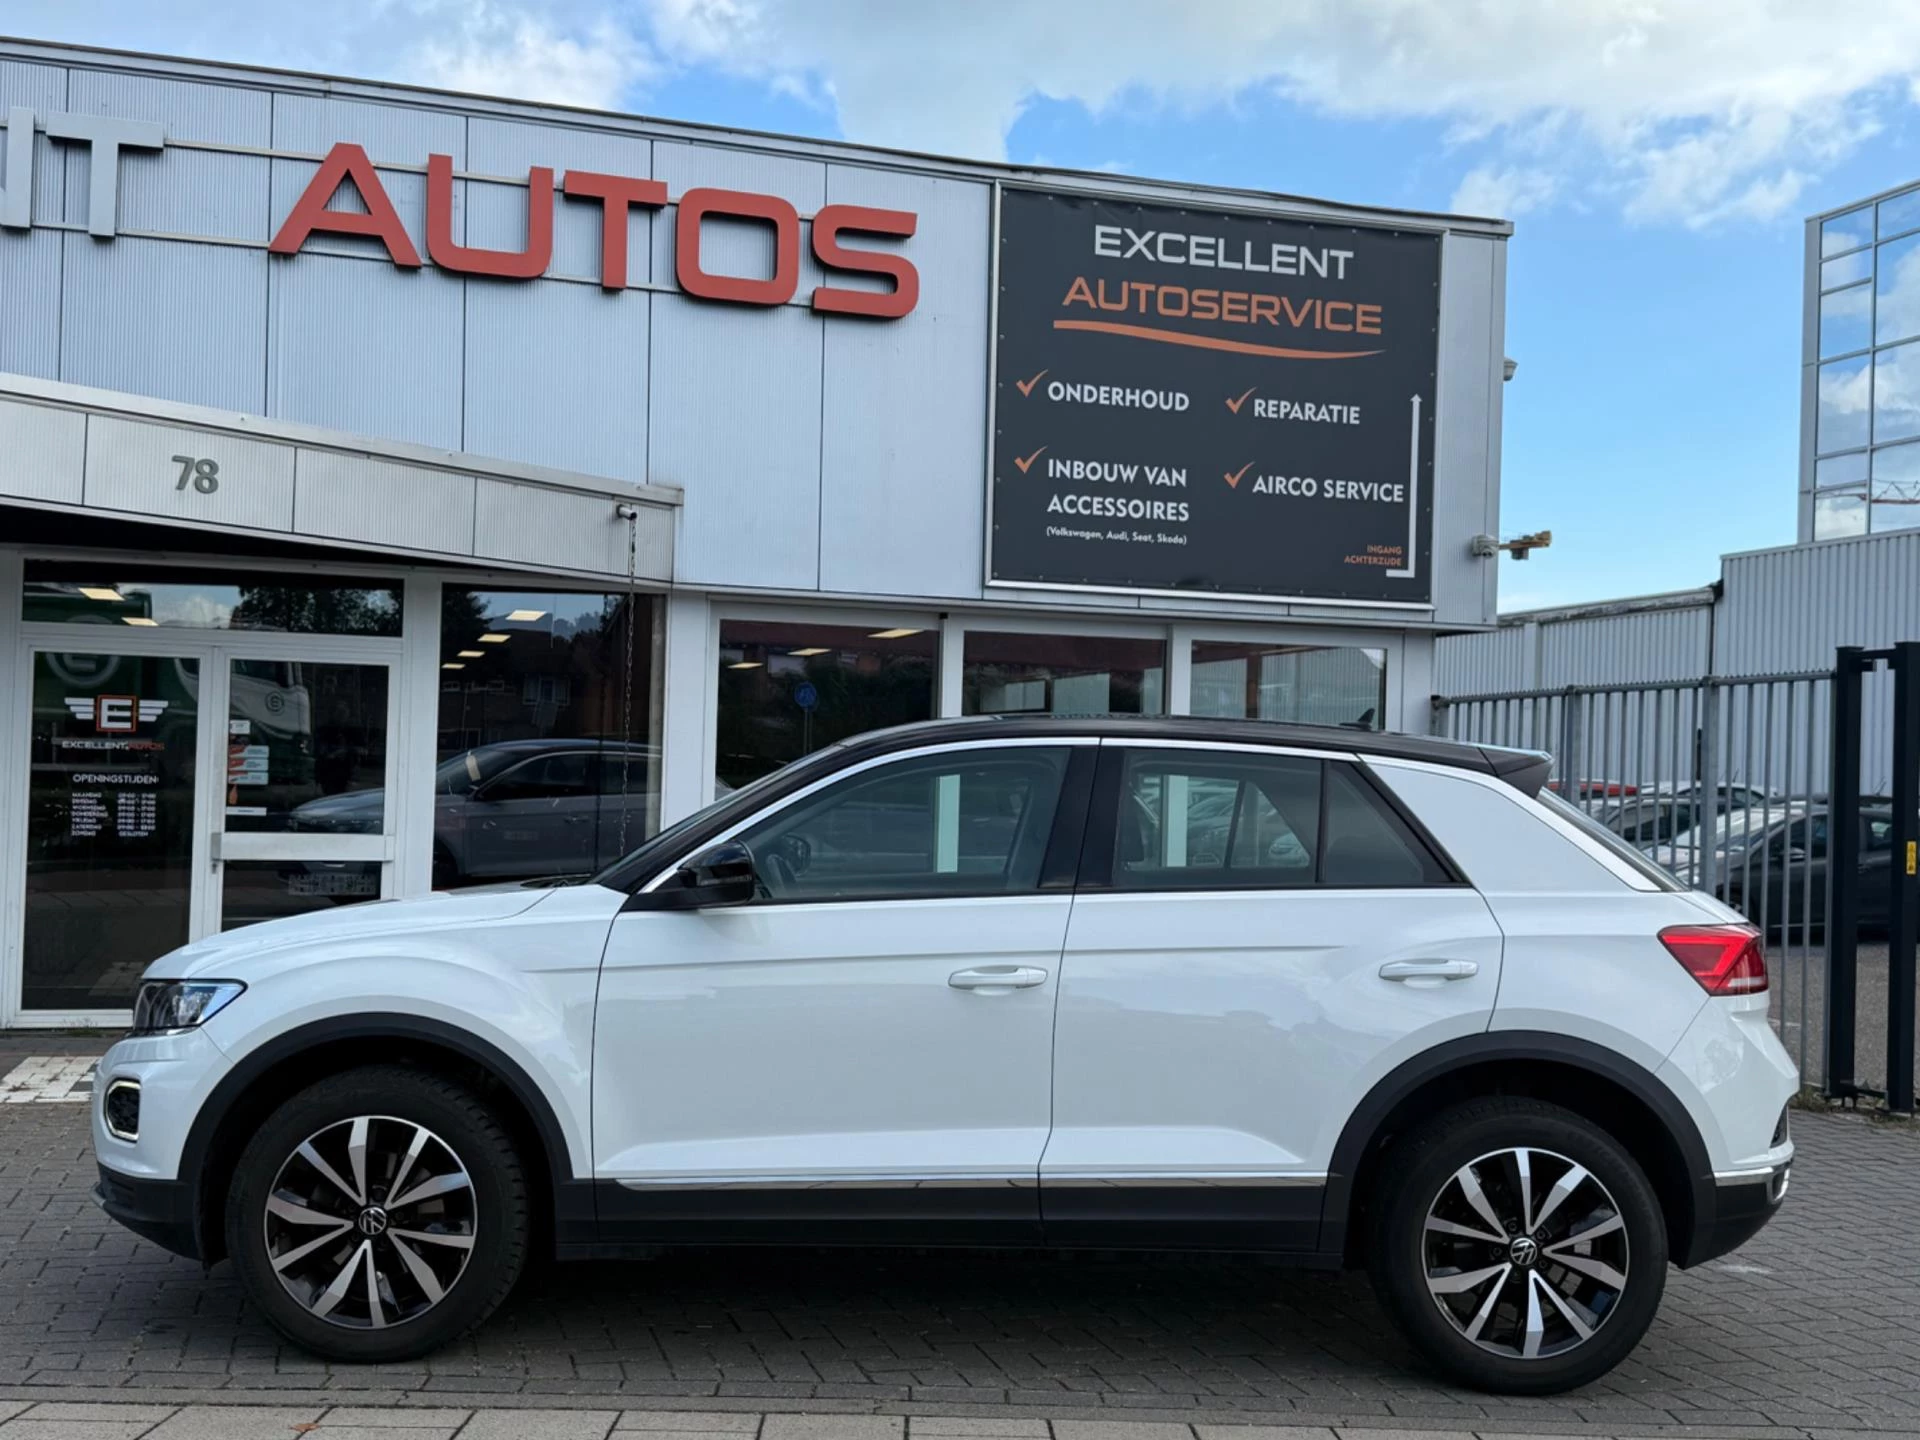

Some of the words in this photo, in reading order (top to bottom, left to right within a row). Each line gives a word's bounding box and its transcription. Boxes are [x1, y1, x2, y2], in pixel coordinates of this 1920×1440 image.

[268, 141, 919, 320] AUTOS
[1094, 224, 1354, 280] EXCELLENT
[1061, 276, 1382, 335] AUTOSERVICE
[1047, 380, 1190, 412] ONDERHOUD
[1253, 399, 1361, 425] REPARATIE
[171, 455, 219, 494] 78
[1047, 458, 1138, 485] INBOUW
[1143, 465, 1187, 488] VAN
[1251, 475, 1317, 498] AIRCO
[1323, 481, 1404, 503] SERVICE
[1046, 494, 1190, 522] ACCESSOIRES
[1046, 526, 1104, 540] (Volkswagen,
[1106, 530, 1129, 542] Audi,
[1132, 532, 1154, 543] Seat,
[1157, 533, 1187, 545] Skoda)
[1366, 544, 1402, 555] INGANG
